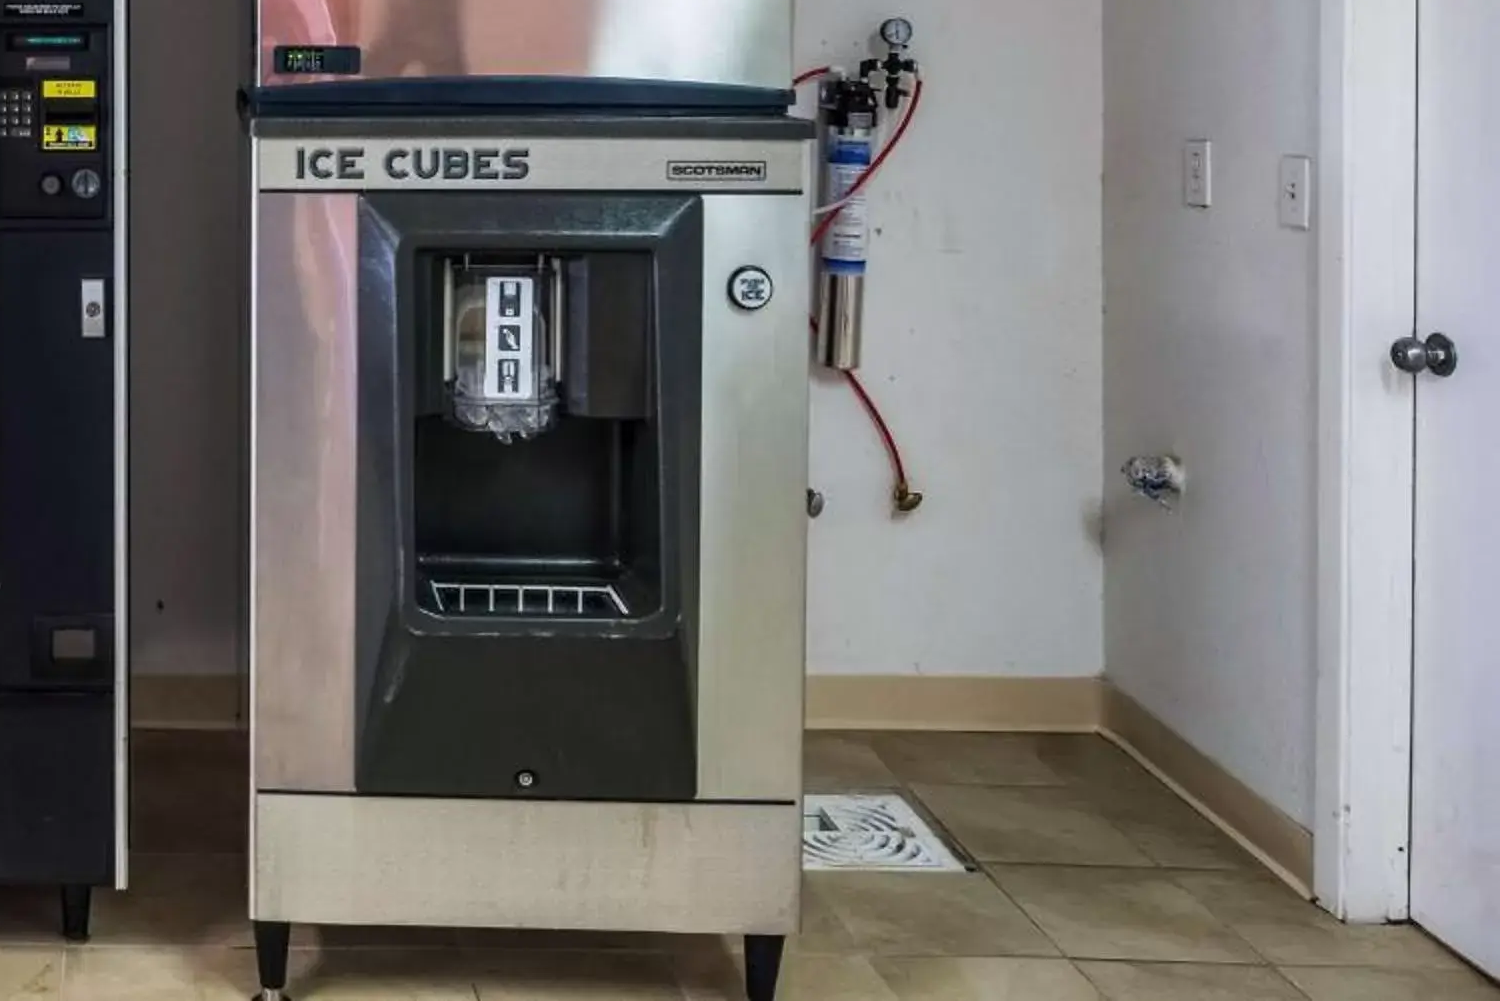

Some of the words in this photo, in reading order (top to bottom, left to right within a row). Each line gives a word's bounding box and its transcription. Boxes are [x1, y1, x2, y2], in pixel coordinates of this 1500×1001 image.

[296, 147, 365, 180] ICE
[384, 147, 530, 180] CUBES
[672, 165, 762, 176] SCOTSMAN
[741, 289, 765, 301] ICE
